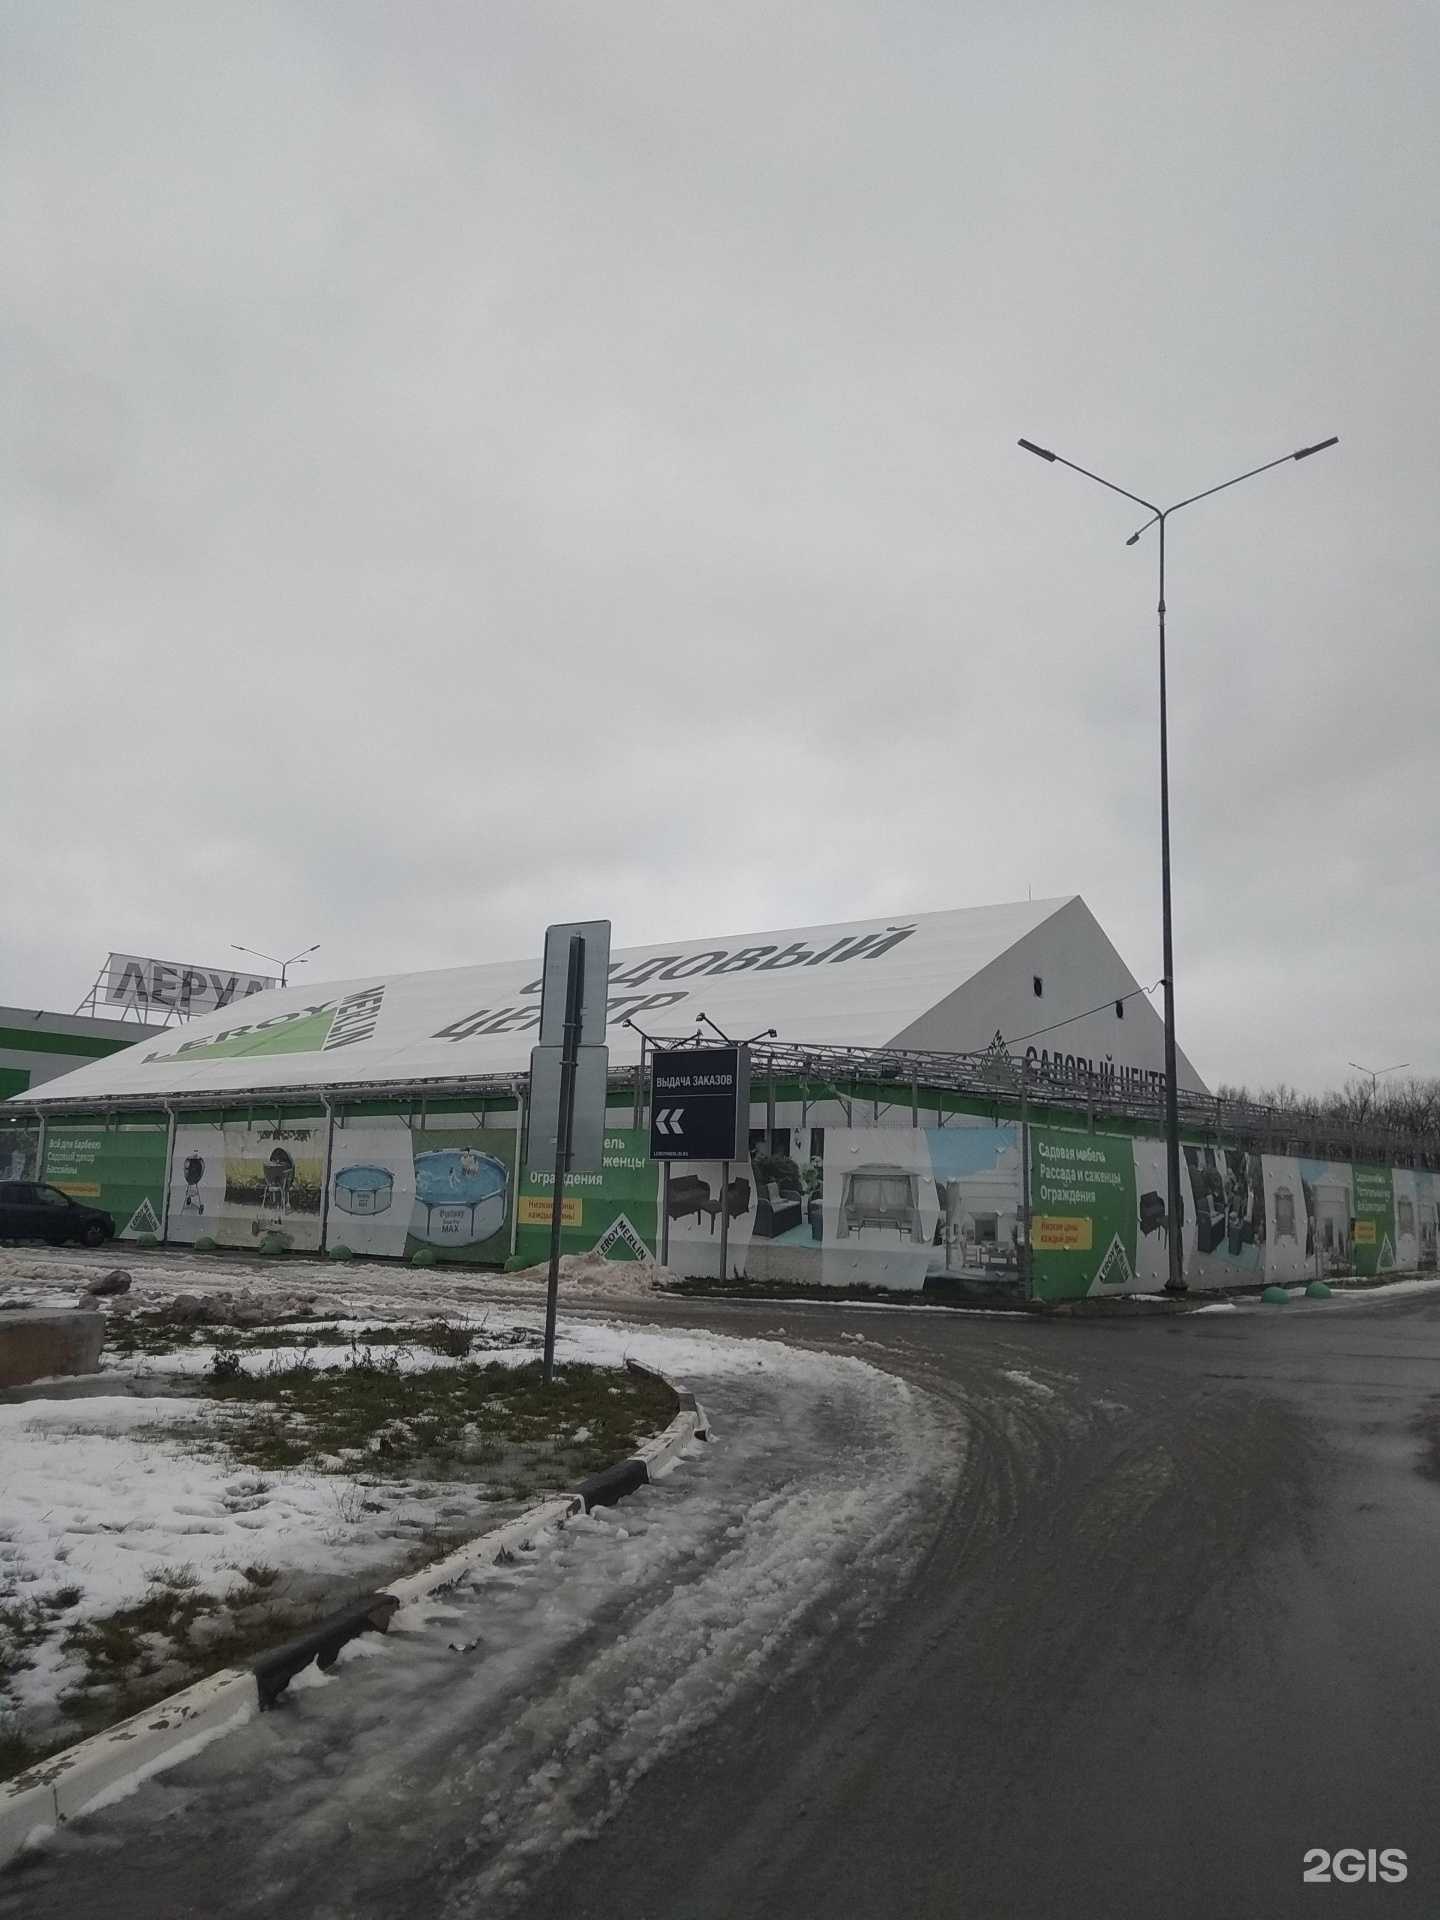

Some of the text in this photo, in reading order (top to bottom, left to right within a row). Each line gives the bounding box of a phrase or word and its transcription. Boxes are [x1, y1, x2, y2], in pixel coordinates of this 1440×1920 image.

[519, 923, 917, 994] ДОВЫЙ
[322, 984, 386, 1051] MERLIN
[429, 991, 690, 1042] ЦЕТР
[141, 1000, 338, 1064] LEROY
[656, 1075, 733, 1088] ВЫДАЧА ЗАКАЗОВ
[604, 1138, 625, 1149] ель
[1039, 1142, 1075, 1161] Садовая
[603, 1157, 645, 1172] женцы
[1040, 1163, 1120, 1187] Рассада и саженцы
[530, 1171, 603, 1187] Оградения
[1040, 1185, 1096, 1205] Ограждения
[597, 1226, 621, 1257] LEROY
[617, 1220, 647, 1261] MERLIN
